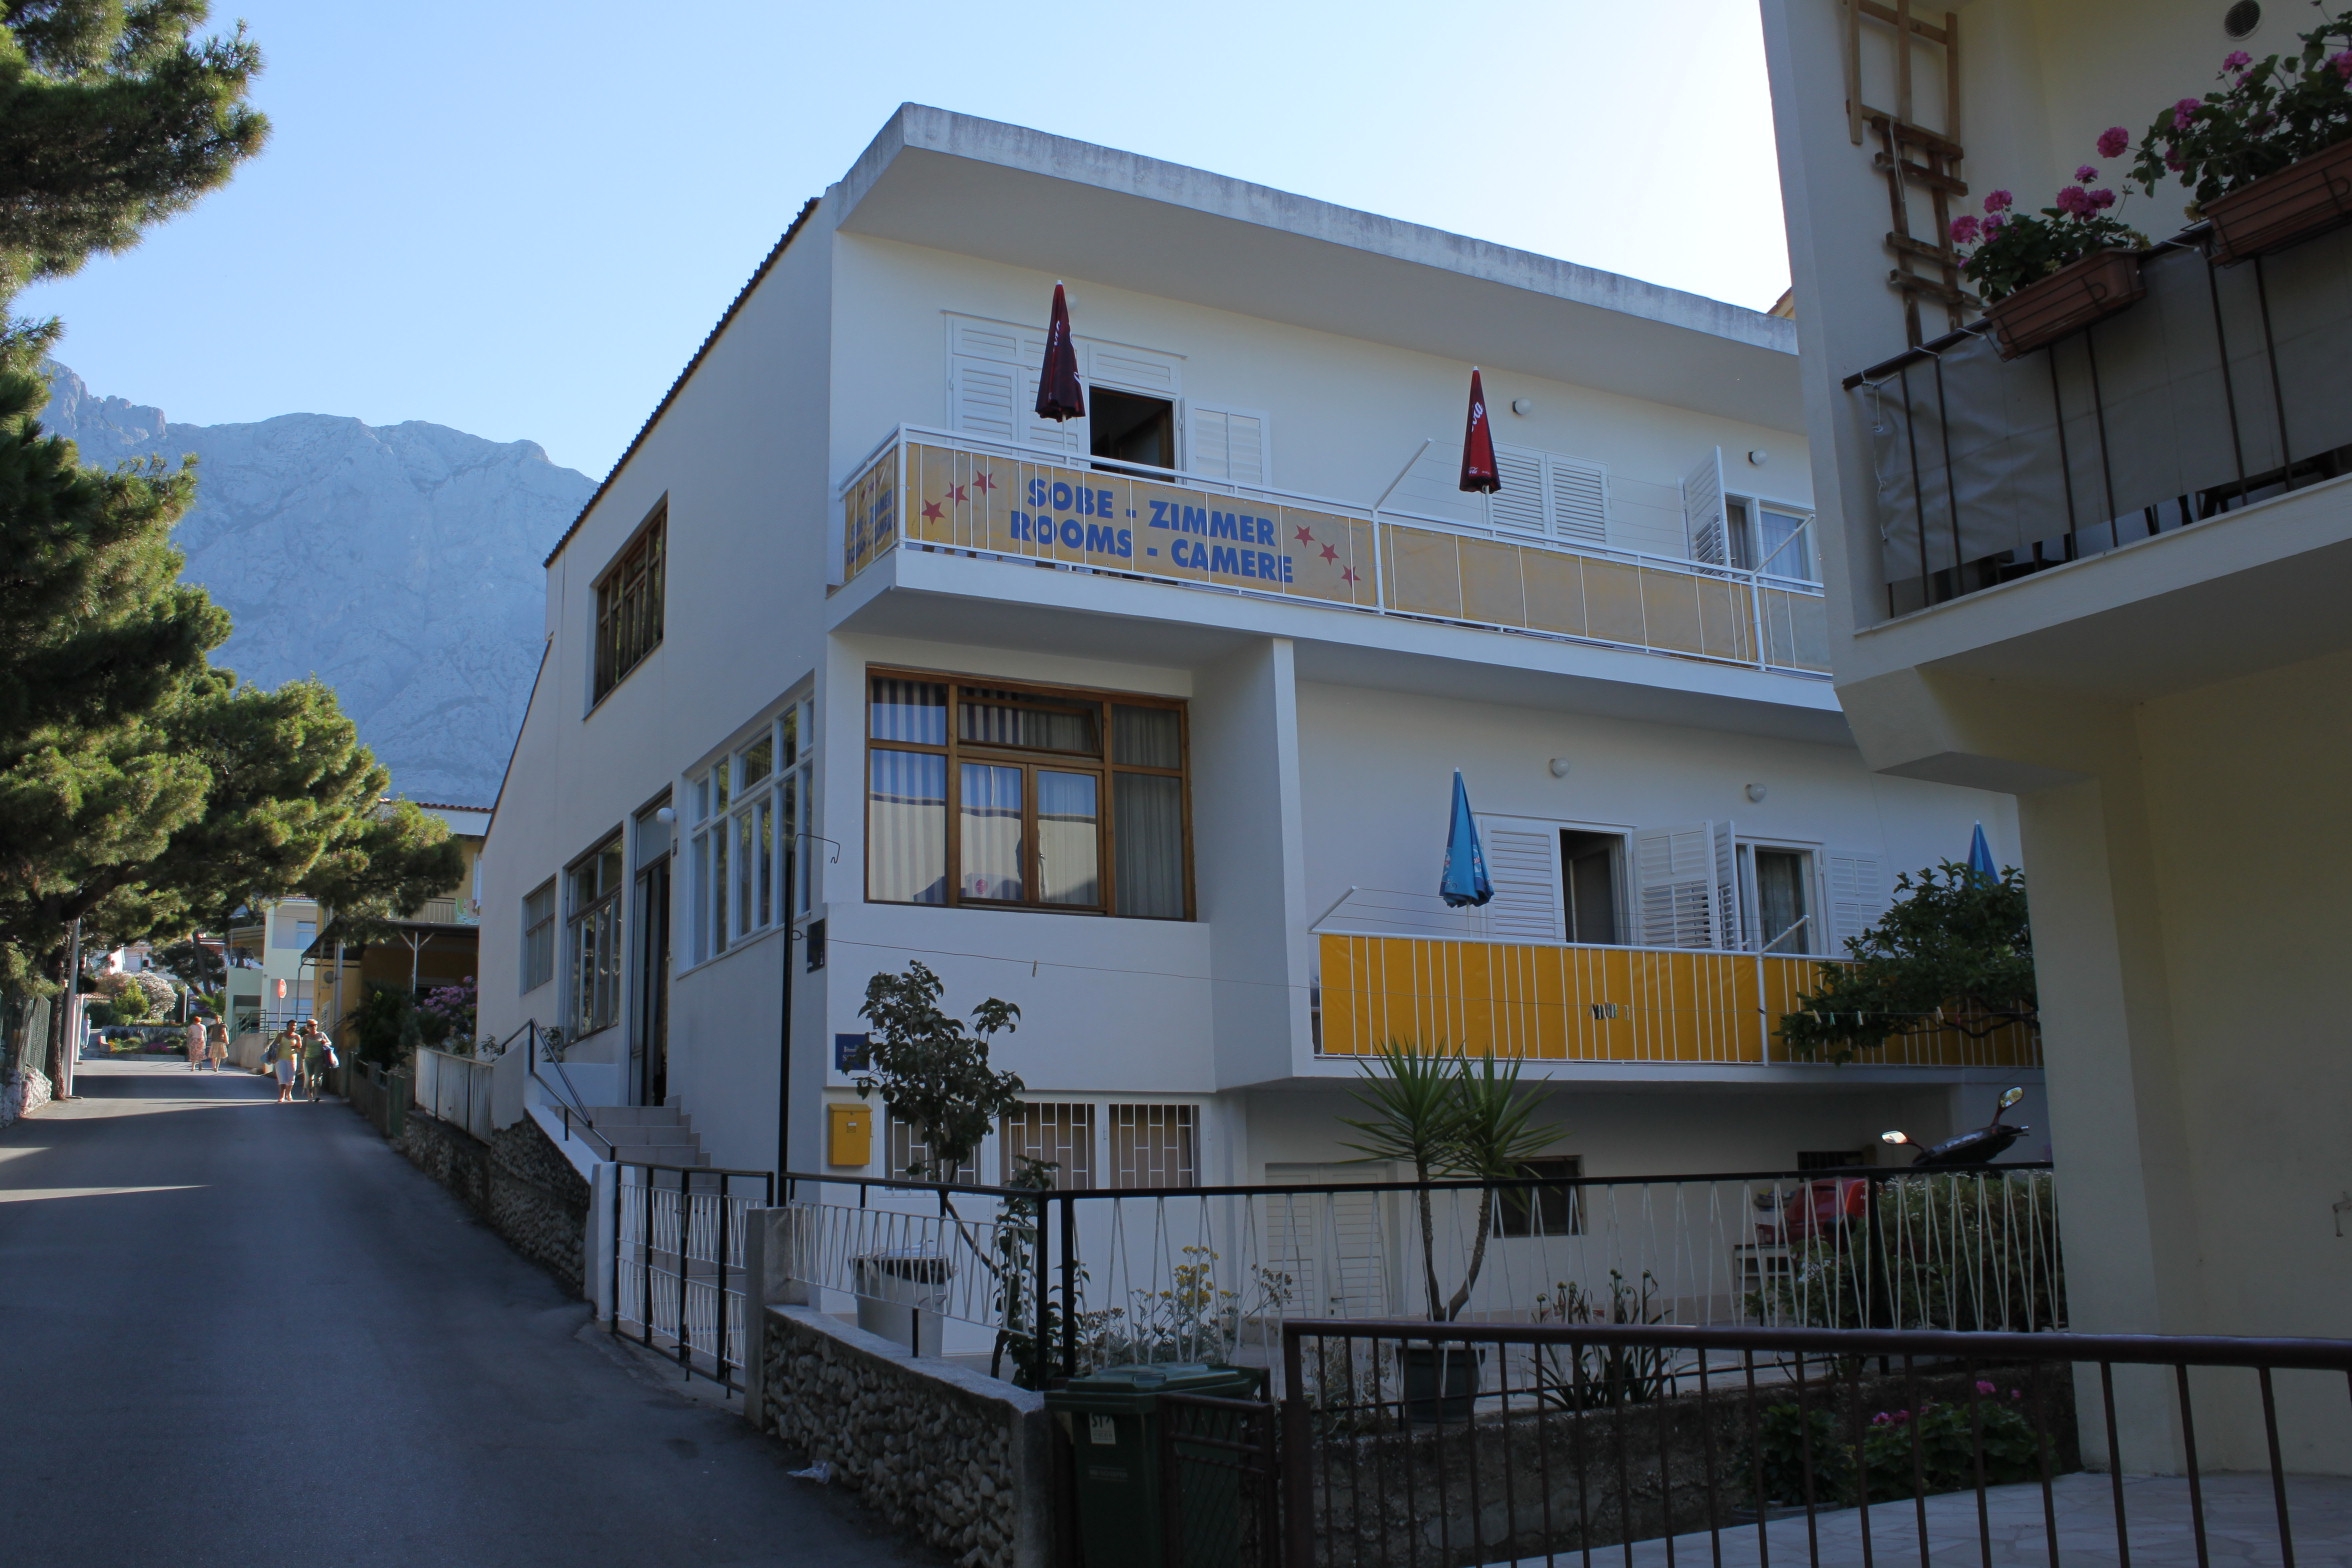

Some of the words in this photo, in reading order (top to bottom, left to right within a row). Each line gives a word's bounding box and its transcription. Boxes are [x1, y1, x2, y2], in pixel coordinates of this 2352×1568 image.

[1010, 510, 1132, 558] ROOMS
[1170, 538, 1294, 583] CAMERE
[1027, 478, 1114, 519] SOBE
[1148, 500, 1276, 547] ZIMMER
